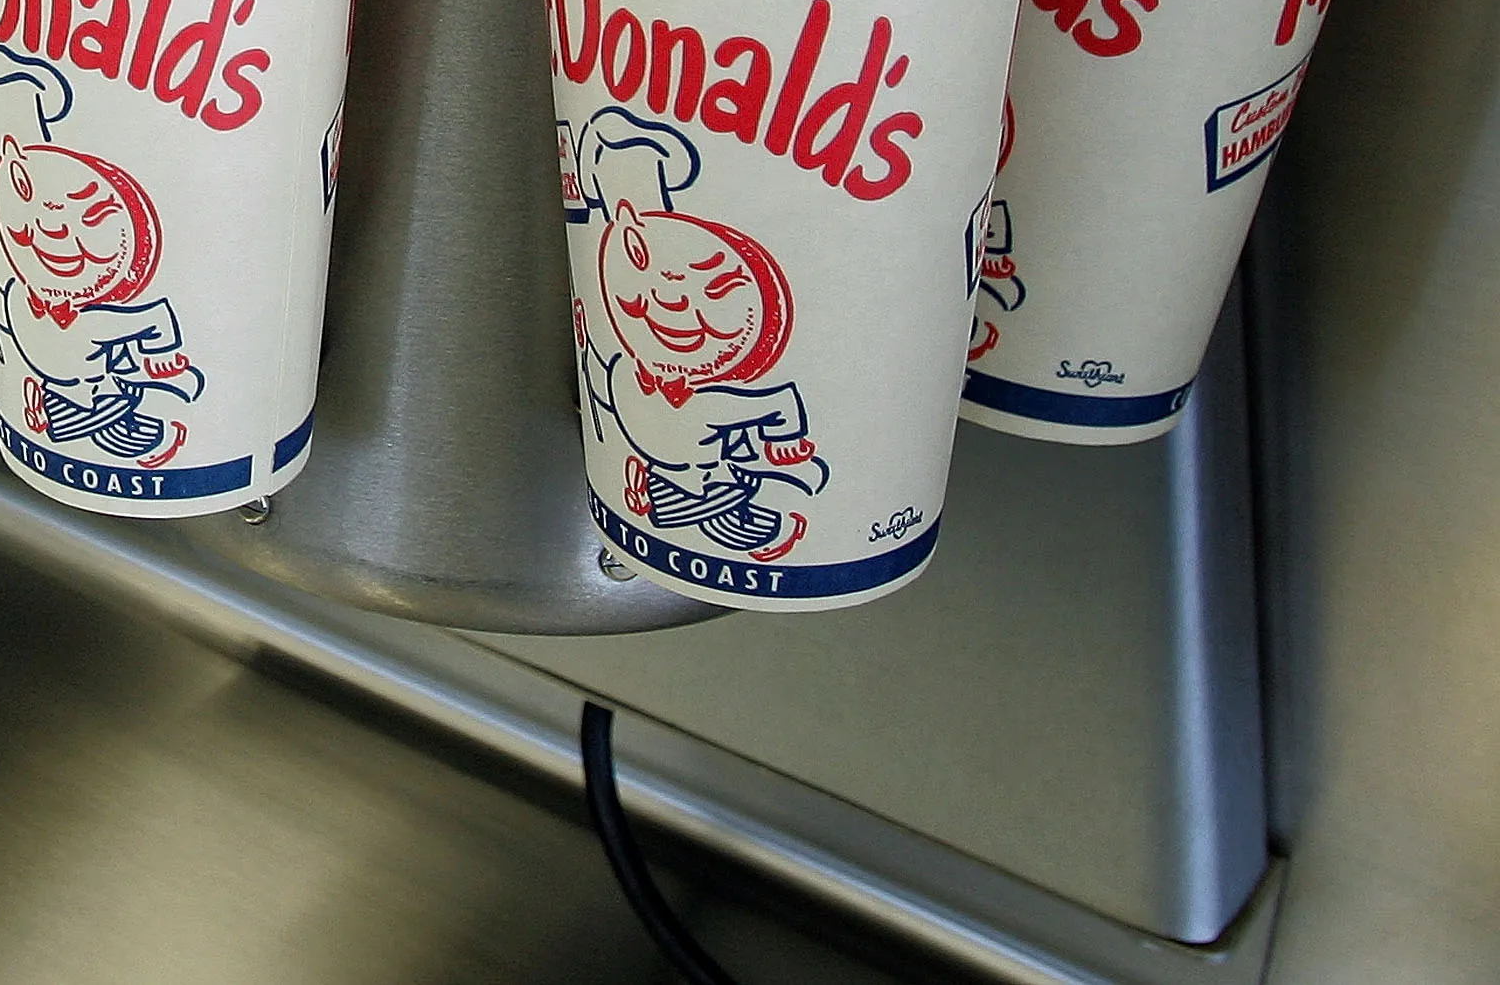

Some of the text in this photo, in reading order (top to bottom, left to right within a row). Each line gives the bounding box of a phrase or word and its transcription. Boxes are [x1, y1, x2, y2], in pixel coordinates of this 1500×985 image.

[20, 442, 47, 472] TO
[62, 463, 165, 496] COAST
[619, 523, 649, 557] TO
[668, 551, 784, 592] COAST
